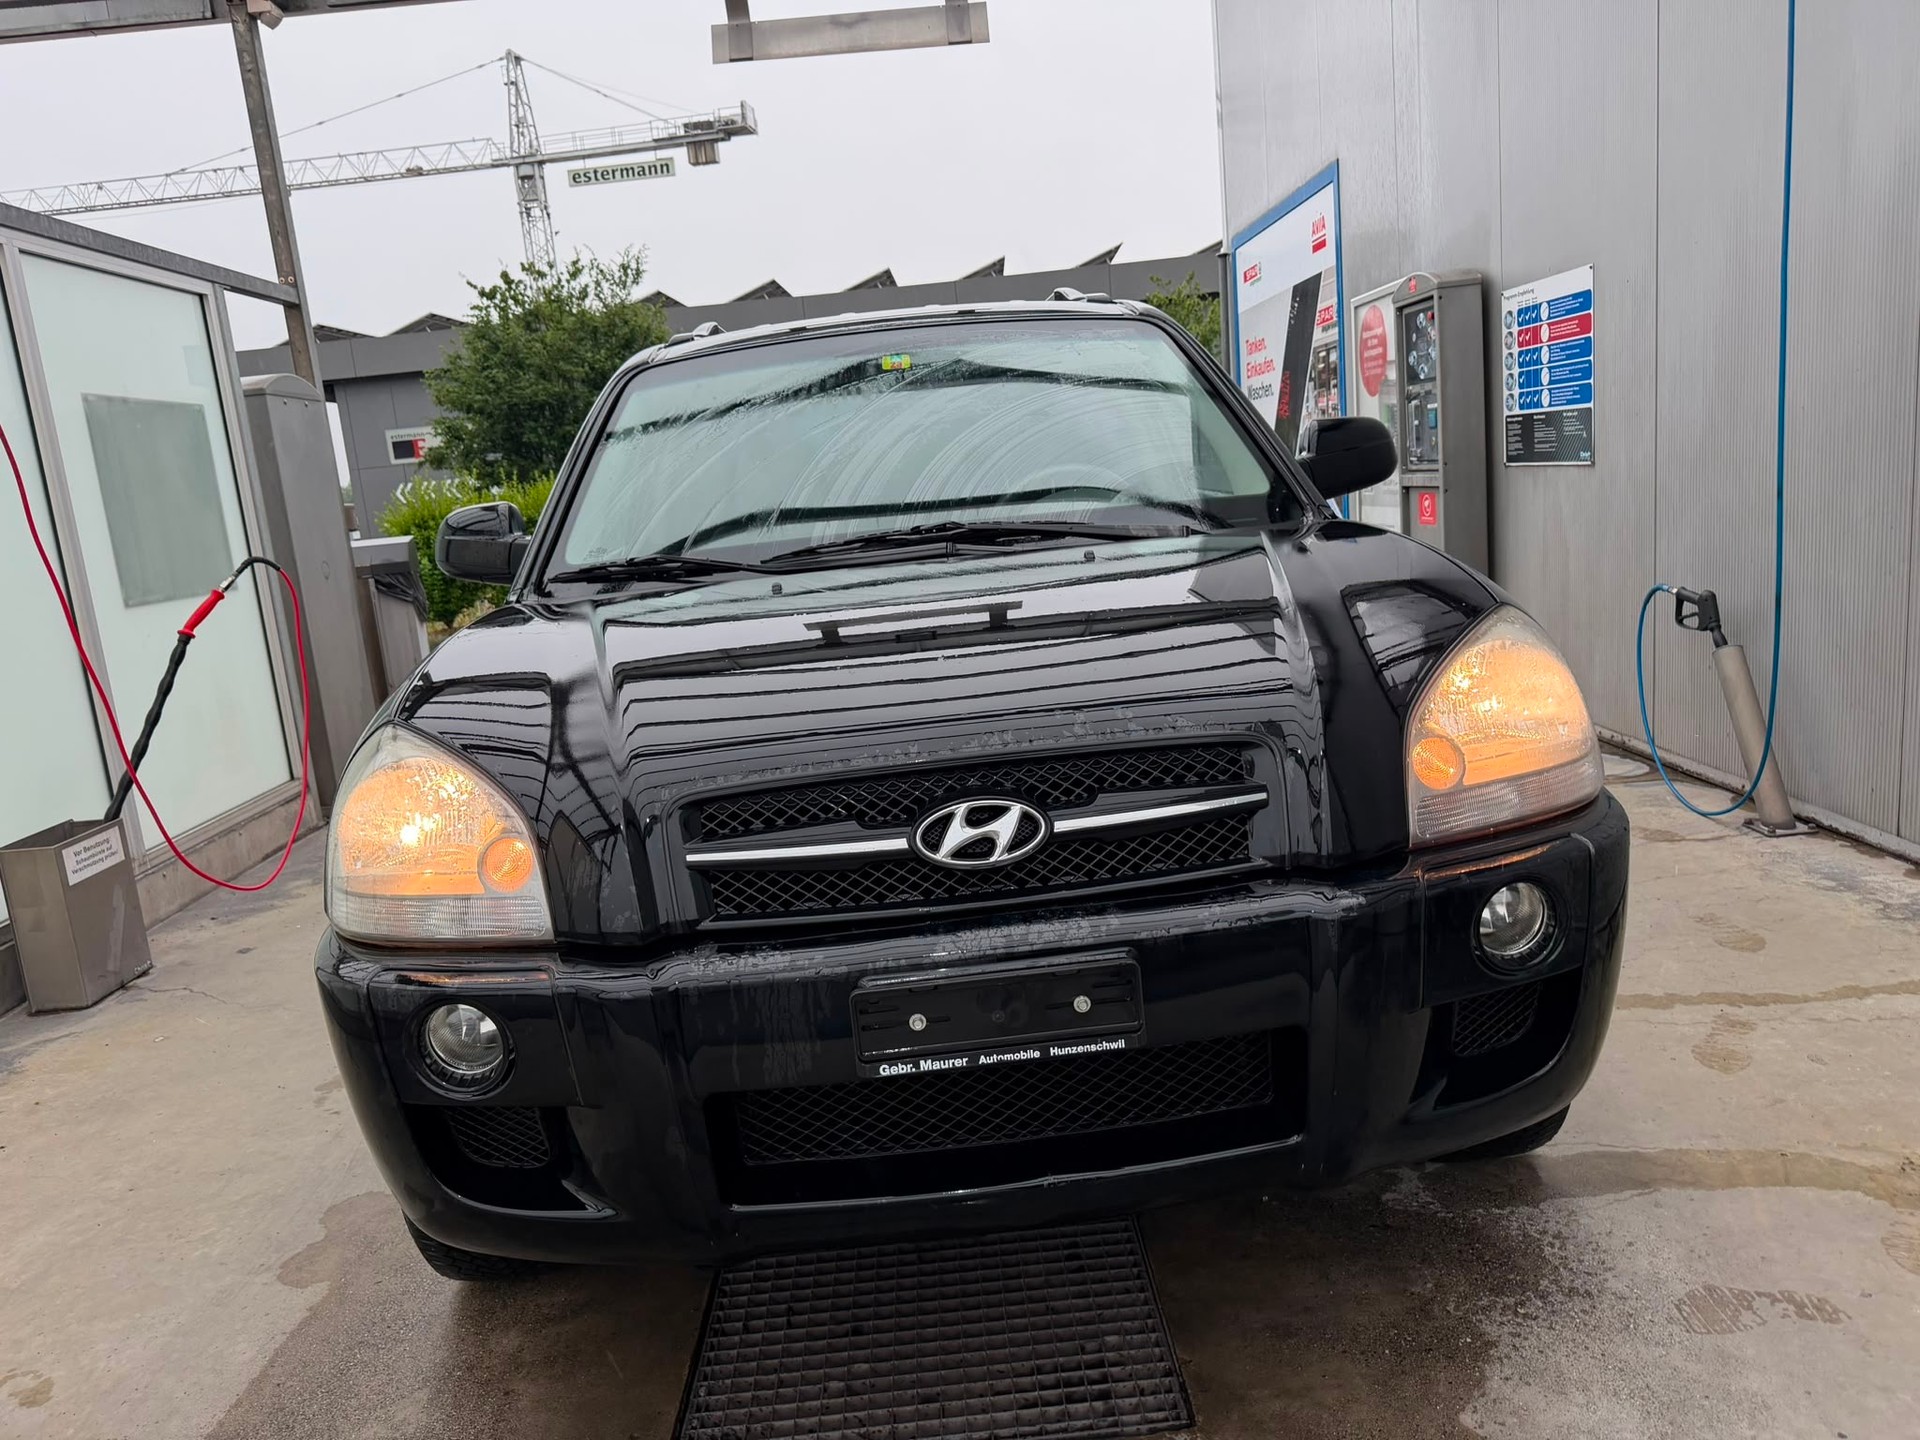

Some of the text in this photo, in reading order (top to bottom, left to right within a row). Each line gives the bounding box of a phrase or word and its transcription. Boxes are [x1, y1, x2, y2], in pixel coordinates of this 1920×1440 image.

[572, 162, 671, 184] estermann
[1317, 306, 1333, 324] SPAR
[1246, 336, 1267, 355] Tanken.
[1247, 357, 1276, 379] Einkaufen.
[879, 1039, 1126, 1076] Gebr. Maurer Automobile Hunzenschwil
